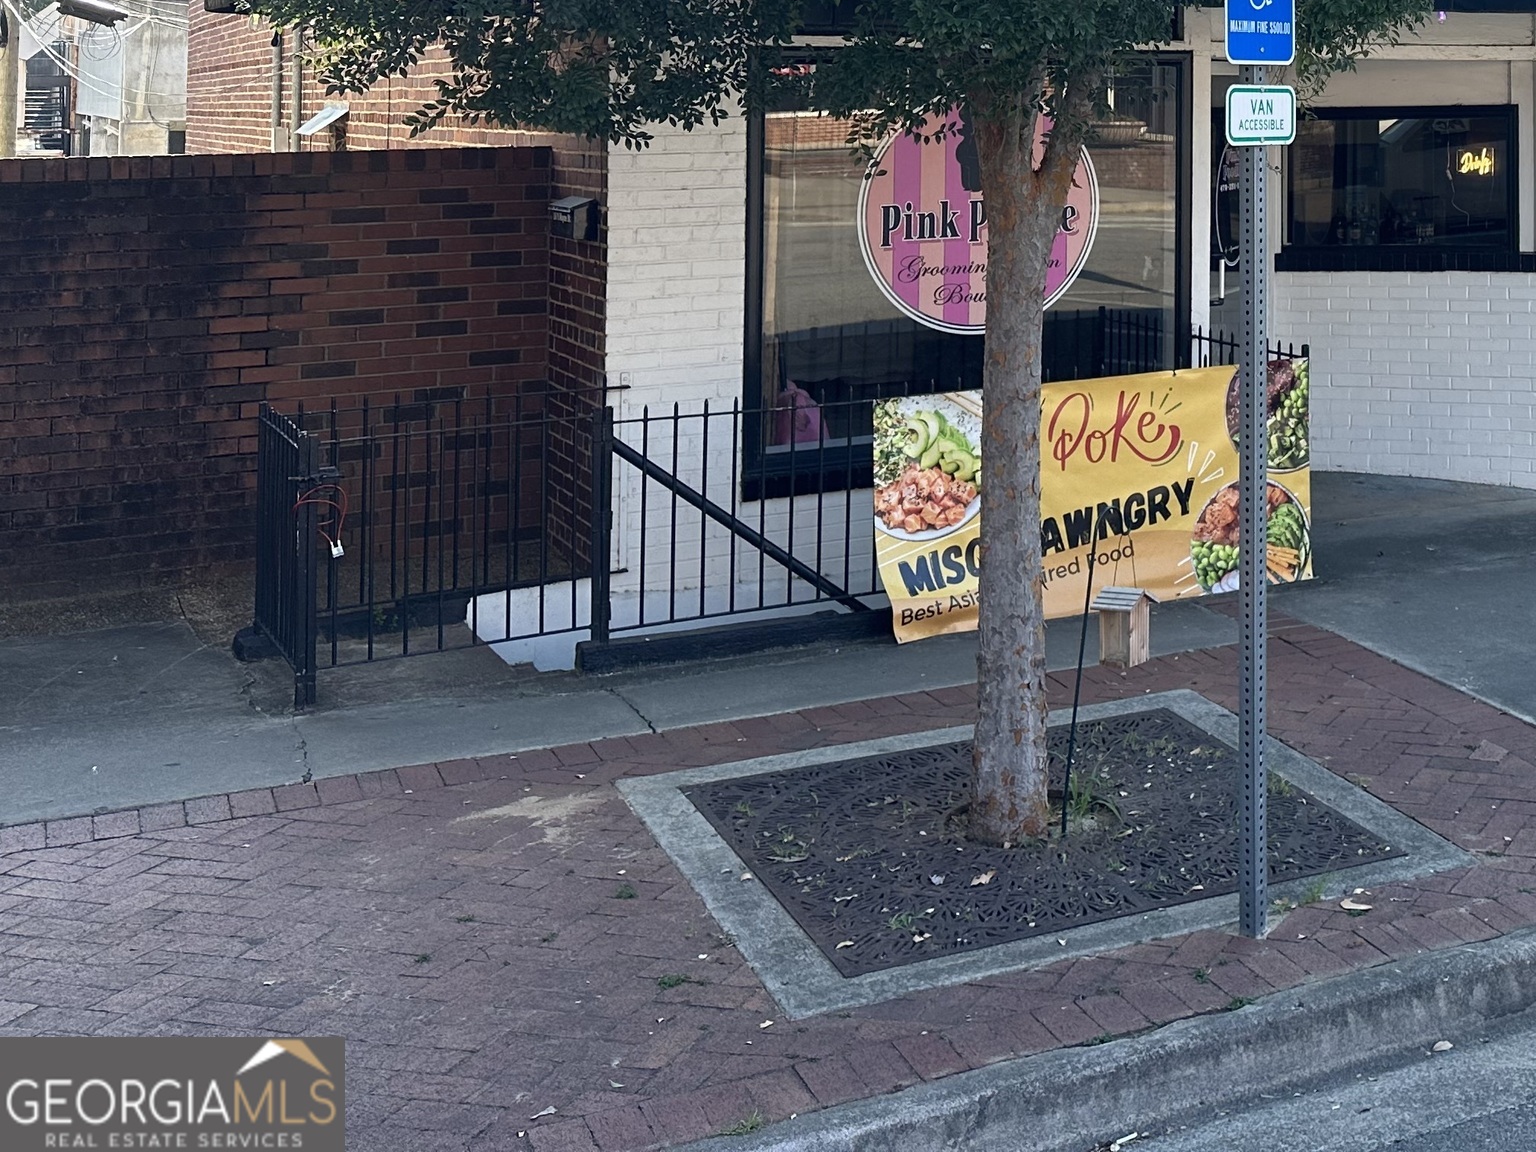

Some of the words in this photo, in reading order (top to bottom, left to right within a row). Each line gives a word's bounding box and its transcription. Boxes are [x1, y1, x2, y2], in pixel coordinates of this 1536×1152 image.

[1230, 19, 1256, 33] MAXIMUM
[1257, 21, 1269, 34] FINE
[1270, 22, 1291, 35] $500.00
[1250, 99, 1274, 116] VAN
[1238, 119, 1285, 131] ACCESSIBLE
[880, 200, 961, 249] Pink
[897, 254, 988, 284] Groomin
[1040, 477, 1195, 557] AWNGRY
[901, 600, 943, 627] Best
[1041, 556, 1080, 584] ired
[1086, 543, 1135, 570] Food
